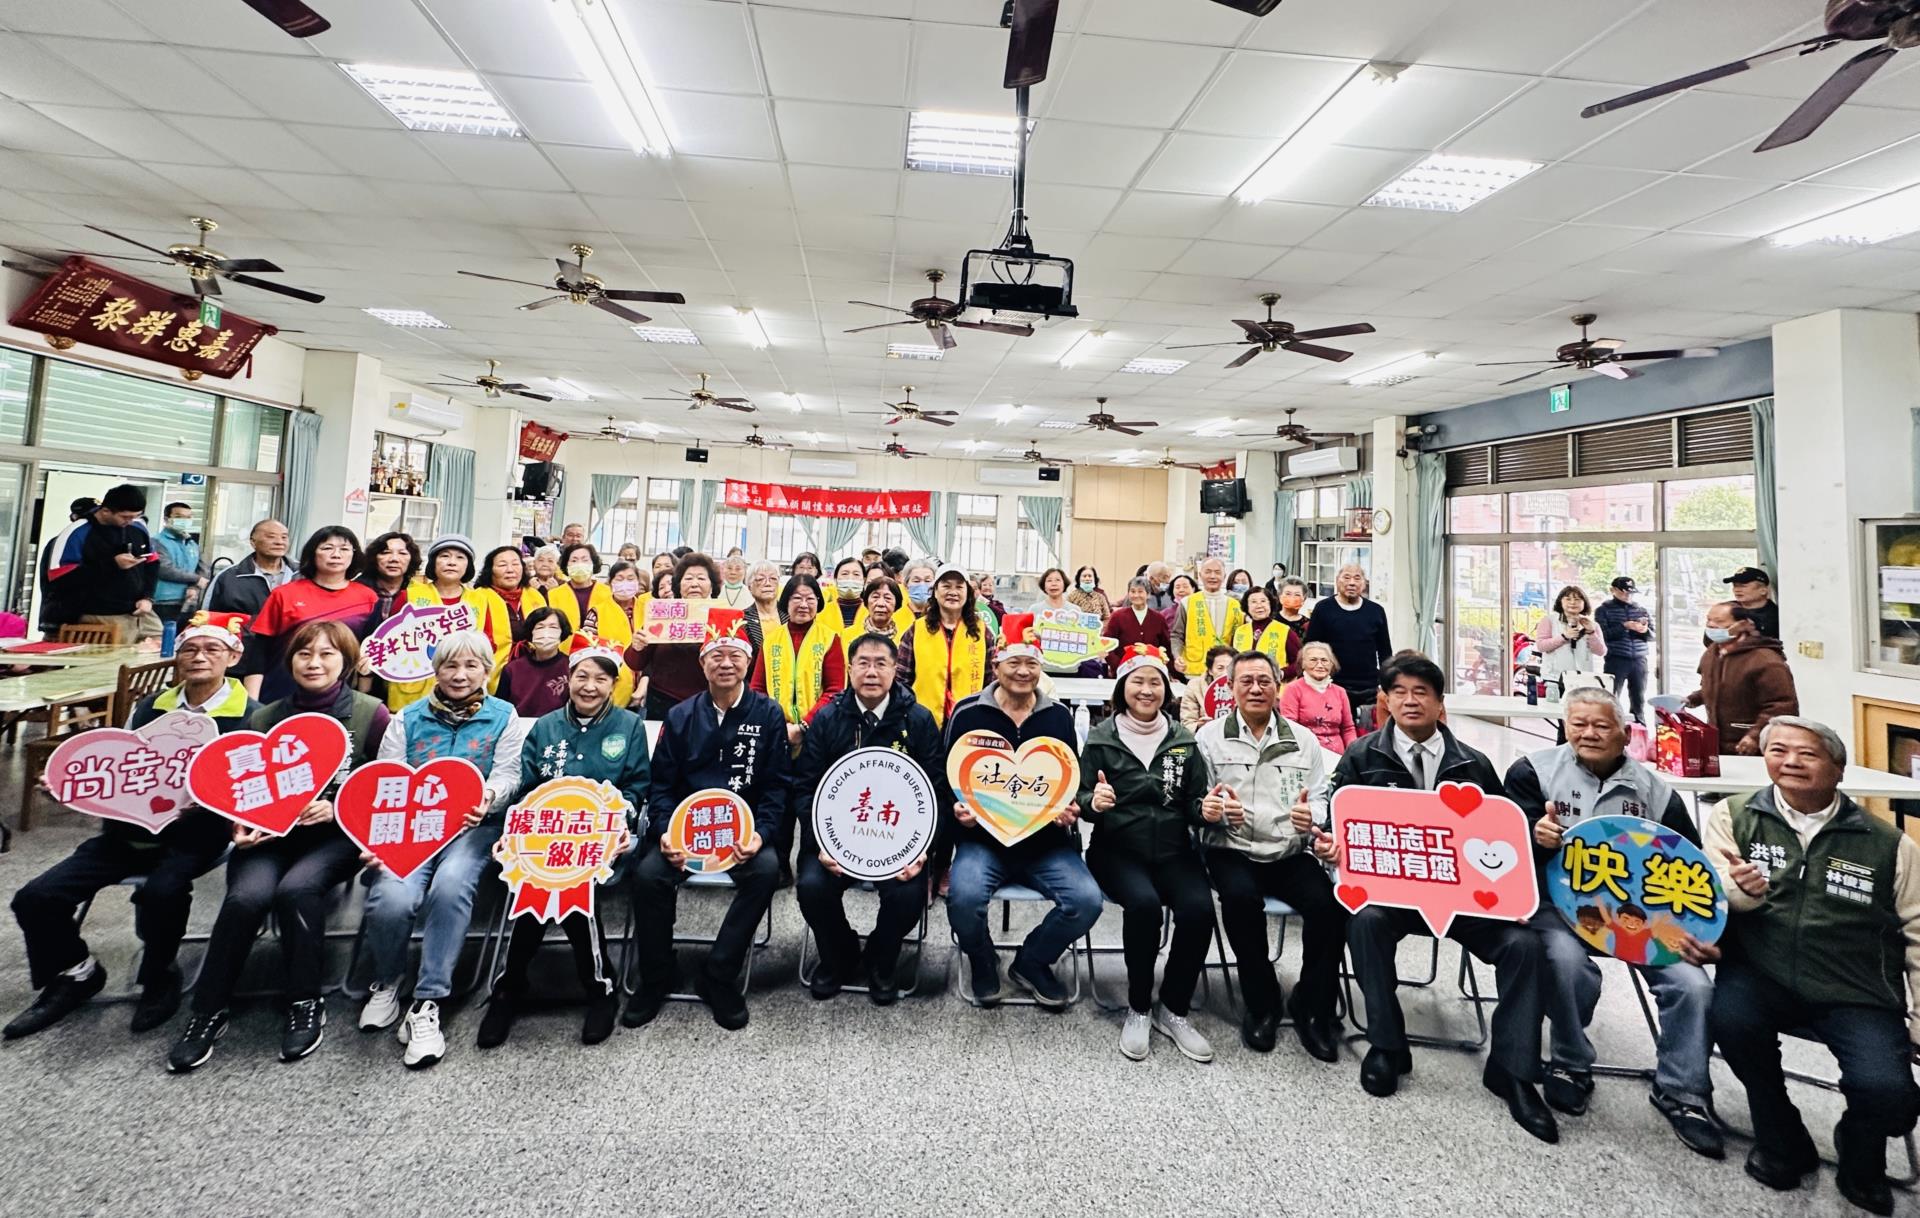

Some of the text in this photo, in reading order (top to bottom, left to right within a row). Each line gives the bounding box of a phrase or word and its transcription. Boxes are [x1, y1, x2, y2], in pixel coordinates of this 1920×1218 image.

[651, 602, 688, 619] 臺南
[738, 724, 762, 733] KMT
[225, 734, 310, 780] 真心
[231, 761, 315, 813] 溫暖
[371, 773, 449, 809] 用心
[827, 760, 926, 814] SOCIAL AFFAIRS BUREAU
[976, 762, 1050, 799] 社會局
[507, 809, 623, 835] 據點志工
[692, 804, 734, 827] 據點
[850, 786, 901, 827] 臺南
[368, 809, 447, 847] 關懷
[693, 828, 735, 852] 尚讚
[824, 815, 922, 868] TAINAN CITY GOVERNMENT
[852, 825, 896, 841] TAINAN
[1346, 821, 1454, 855] 據點志工
[519, 841, 605, 867] 一級棒
[1348, 847, 1458, 882] 感謝有您
[1564, 837, 1715, 919] 快樂
